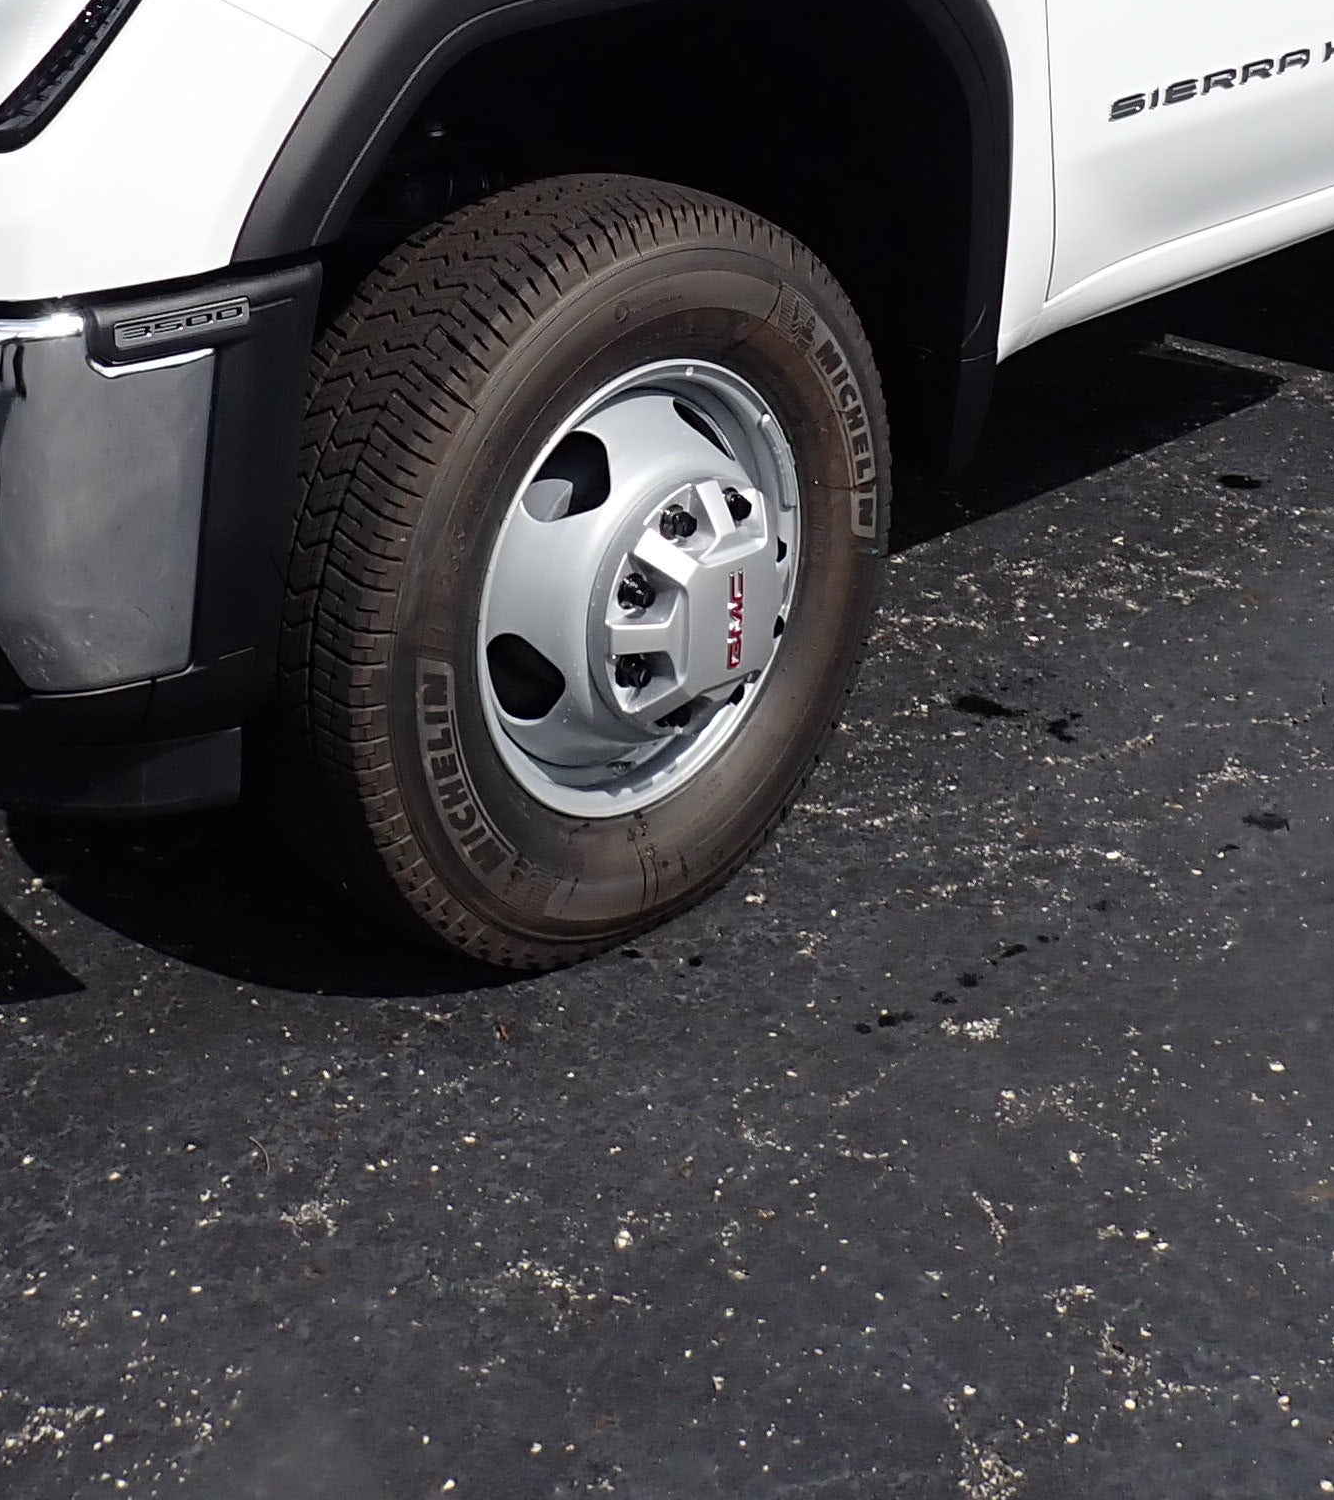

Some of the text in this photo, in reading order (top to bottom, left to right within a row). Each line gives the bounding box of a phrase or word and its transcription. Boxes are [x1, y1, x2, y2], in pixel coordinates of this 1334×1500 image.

[1108, 48, 1310, 123] SIERRA
[122, 306, 244, 341] 3500
[815, 338, 875, 529] MICHELIN
[727, 568, 744, 670] GMC
[422, 670, 509, 876] MICHELIN
